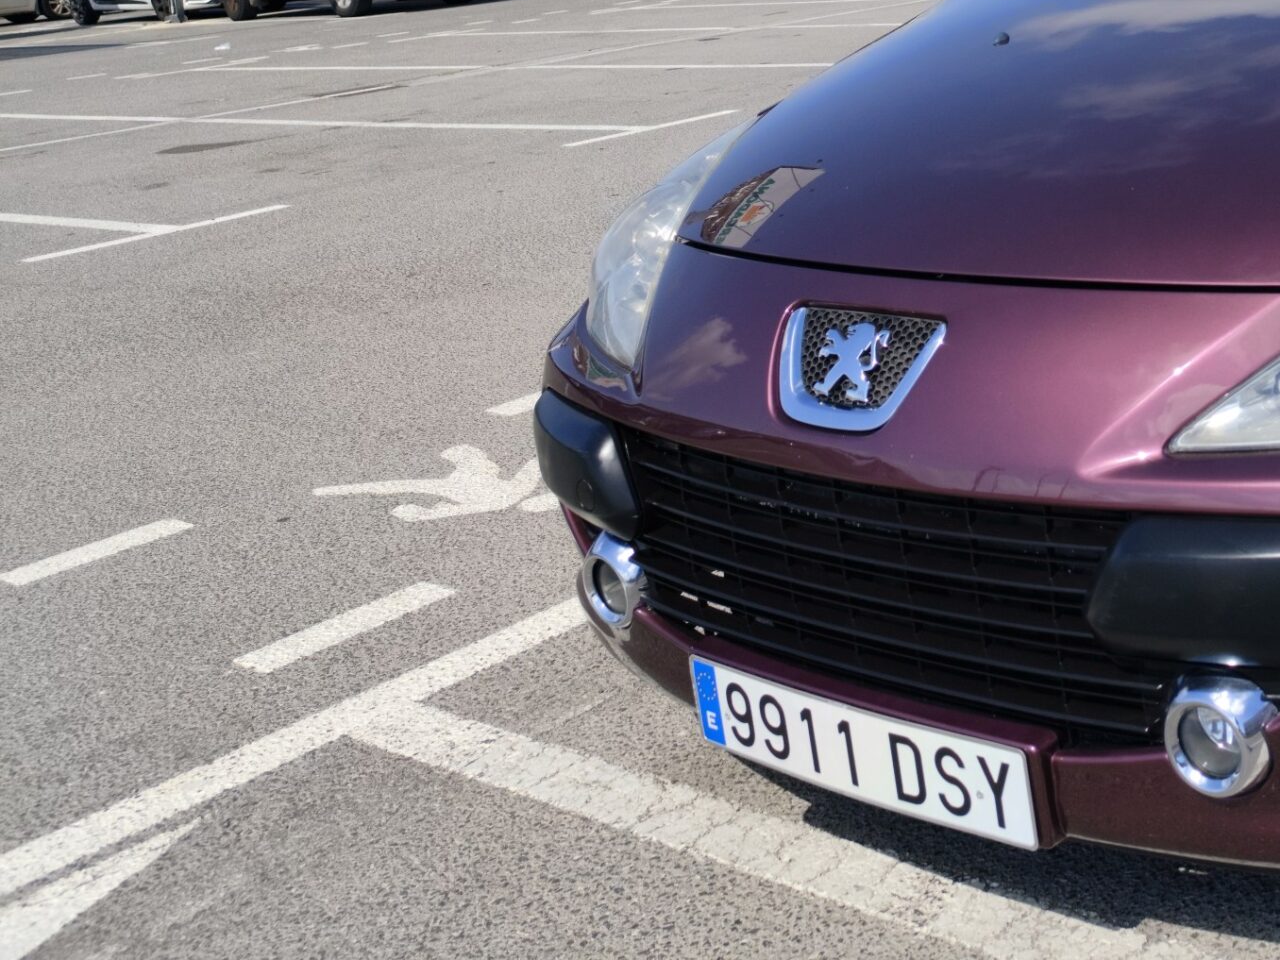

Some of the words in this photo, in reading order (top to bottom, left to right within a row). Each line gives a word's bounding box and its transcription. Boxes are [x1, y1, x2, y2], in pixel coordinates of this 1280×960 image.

[704, 711, 719, 731] E
[725, 681, 860, 788] 9911
[888, 731, 1010, 830] DSY
